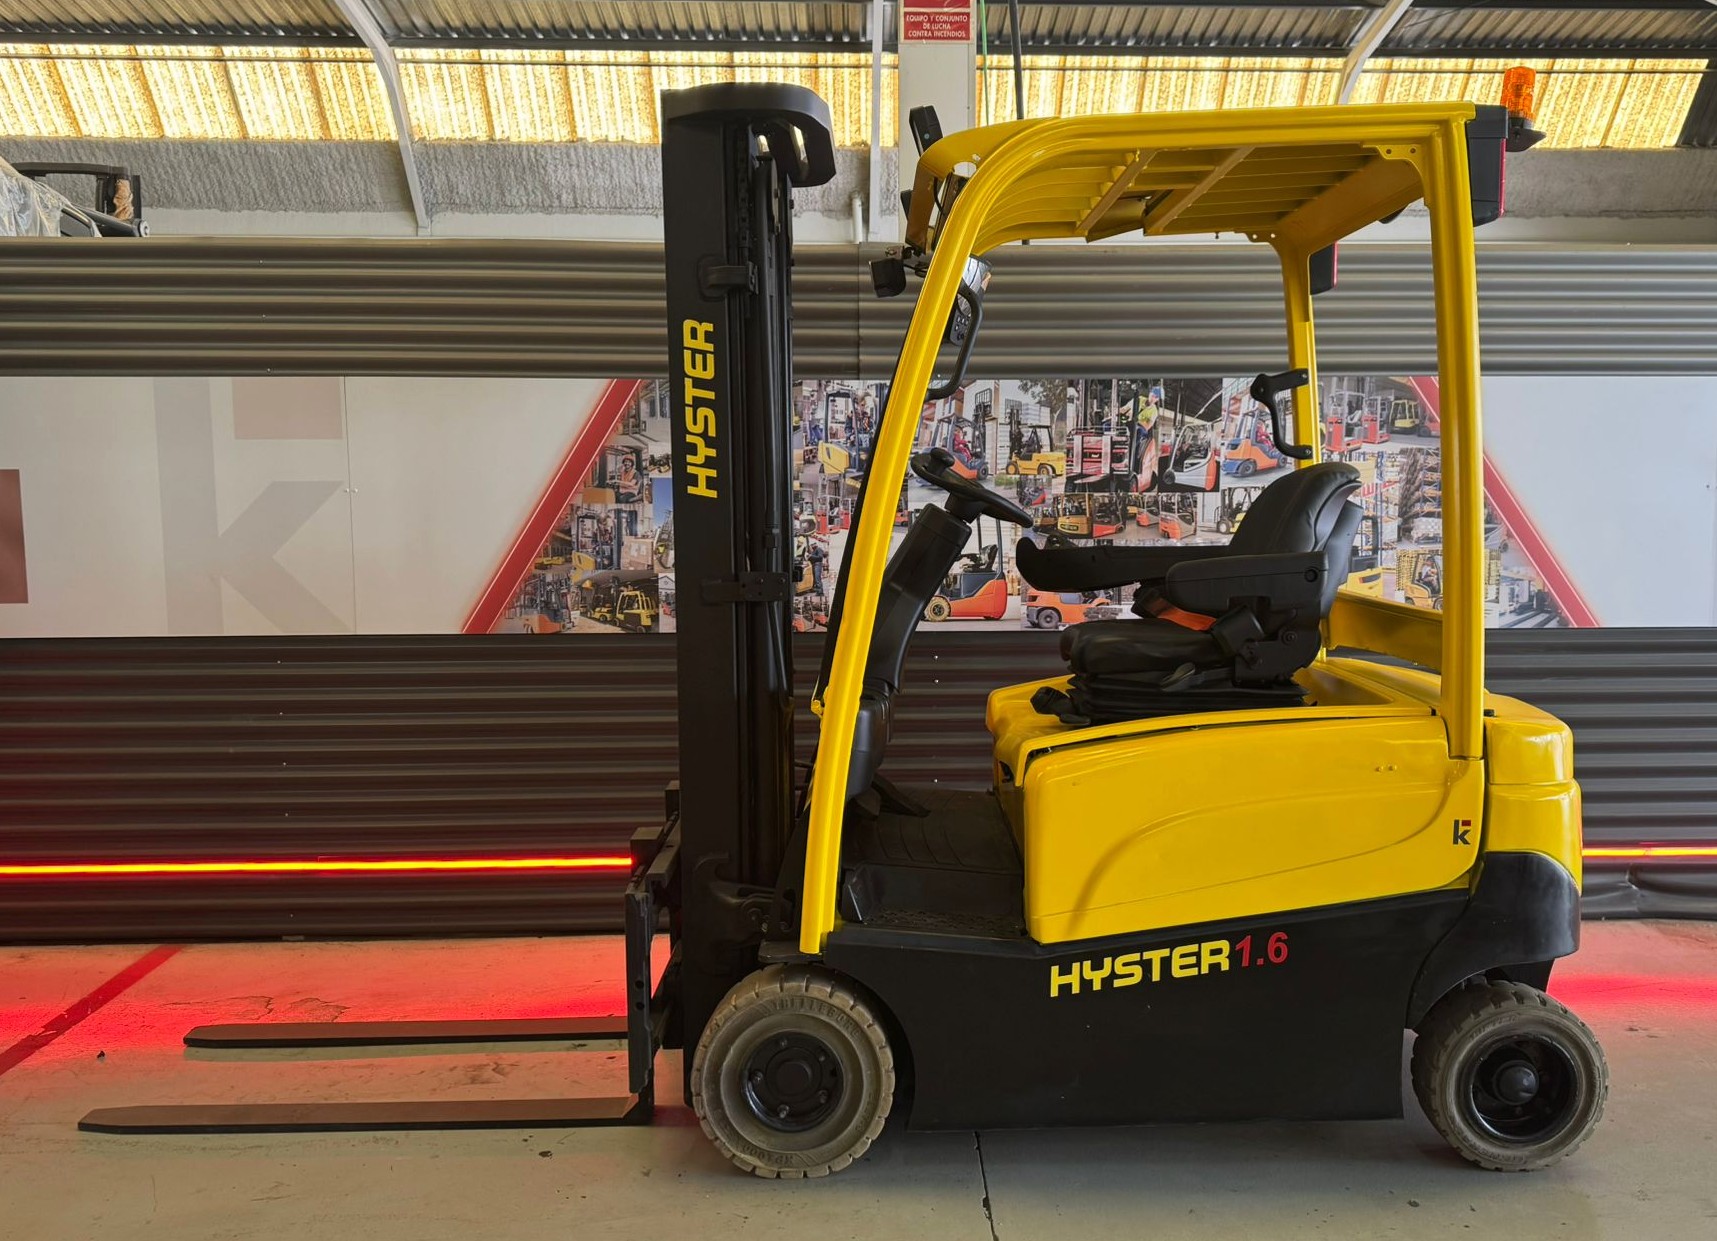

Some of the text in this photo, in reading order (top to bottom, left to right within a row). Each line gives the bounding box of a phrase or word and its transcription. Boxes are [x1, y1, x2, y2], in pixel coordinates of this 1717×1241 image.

[683, 319, 718, 498] HYSTER
[1050, 931, 1289, 998] HYSTER 1.6
